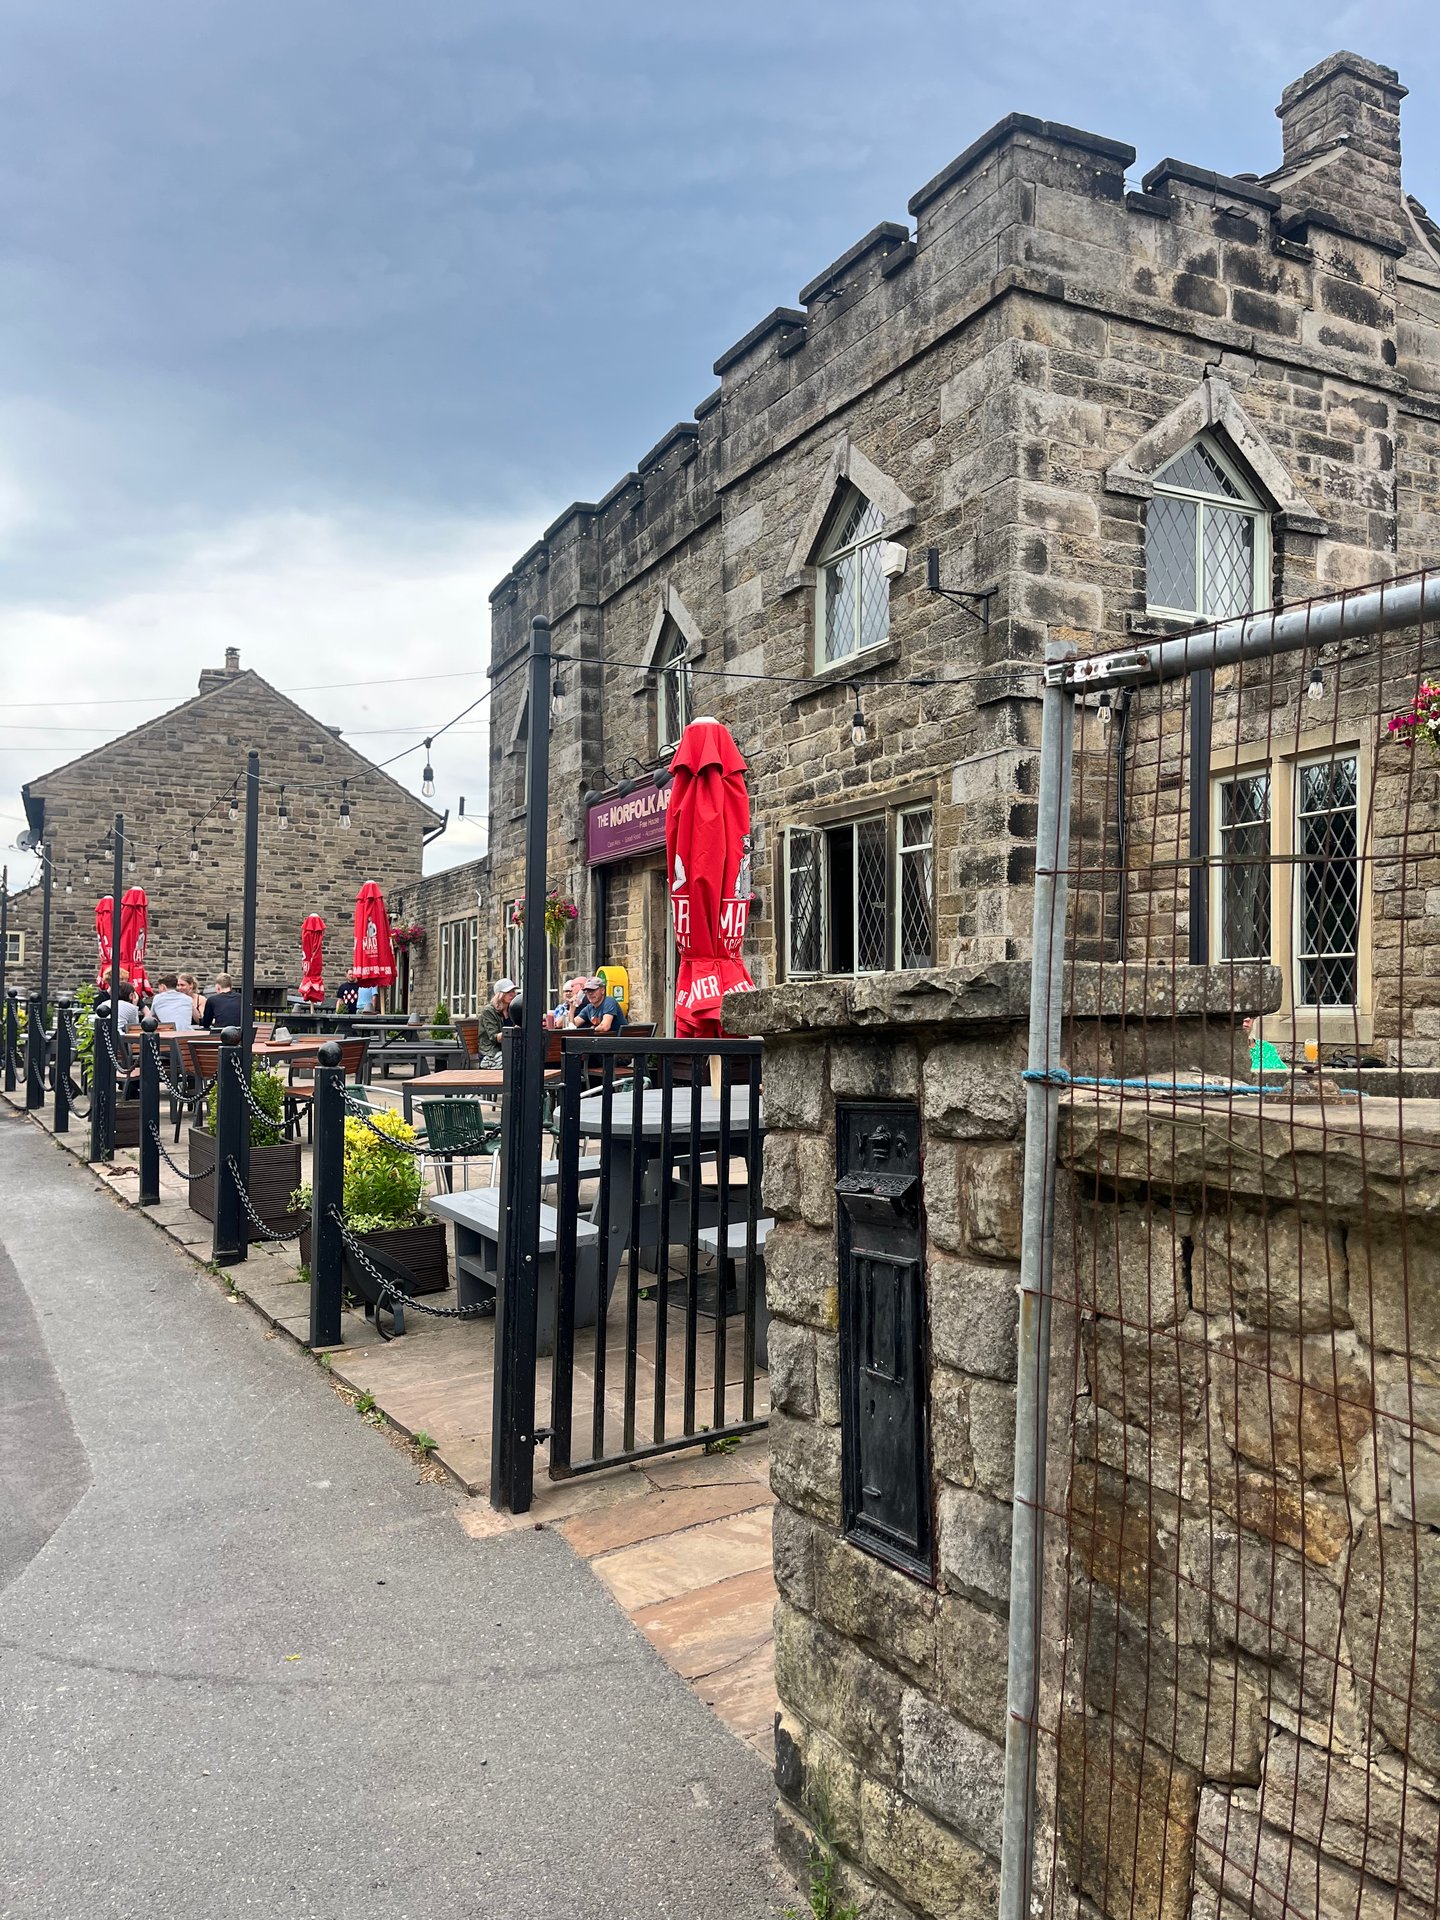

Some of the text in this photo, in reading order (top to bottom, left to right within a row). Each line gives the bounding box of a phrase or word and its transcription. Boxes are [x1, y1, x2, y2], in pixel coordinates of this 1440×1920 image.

[597, 789, 672, 828] THE NORFOLK AR
